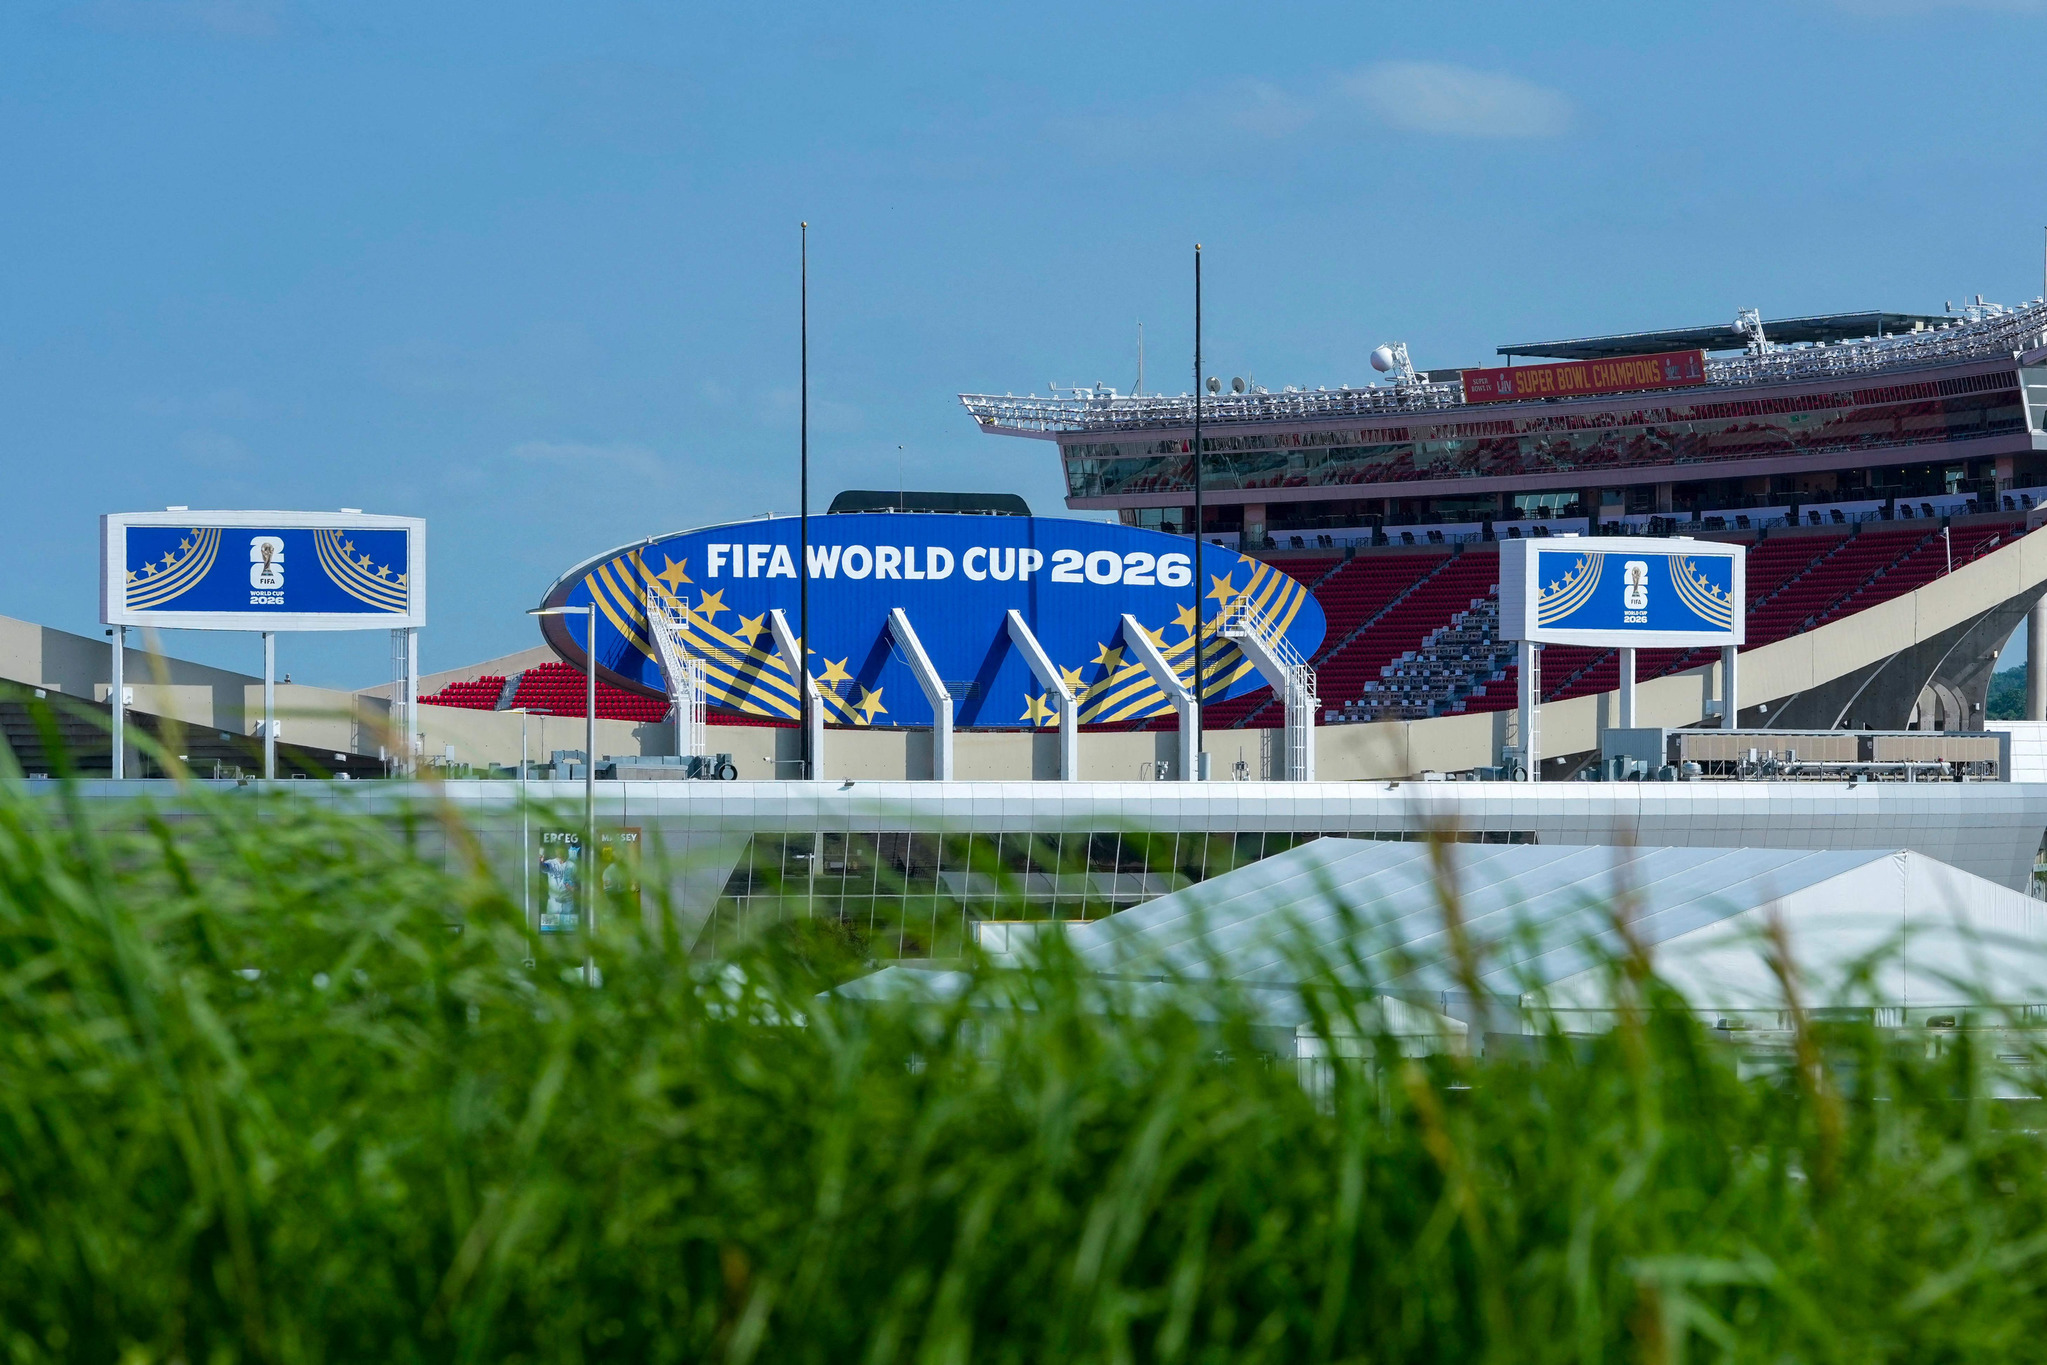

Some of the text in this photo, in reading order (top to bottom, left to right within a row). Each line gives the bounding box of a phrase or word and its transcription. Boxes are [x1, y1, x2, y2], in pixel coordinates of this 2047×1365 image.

[1516, 370, 1555, 393] SUPER
[1556, 366, 1591, 391] BOWL
[1592, 360, 1661, 387] CHAMPIONS
[707, 544, 1192, 587] FIFA WORLD CUP 2026
[601, 833, 637, 842] MSEY
